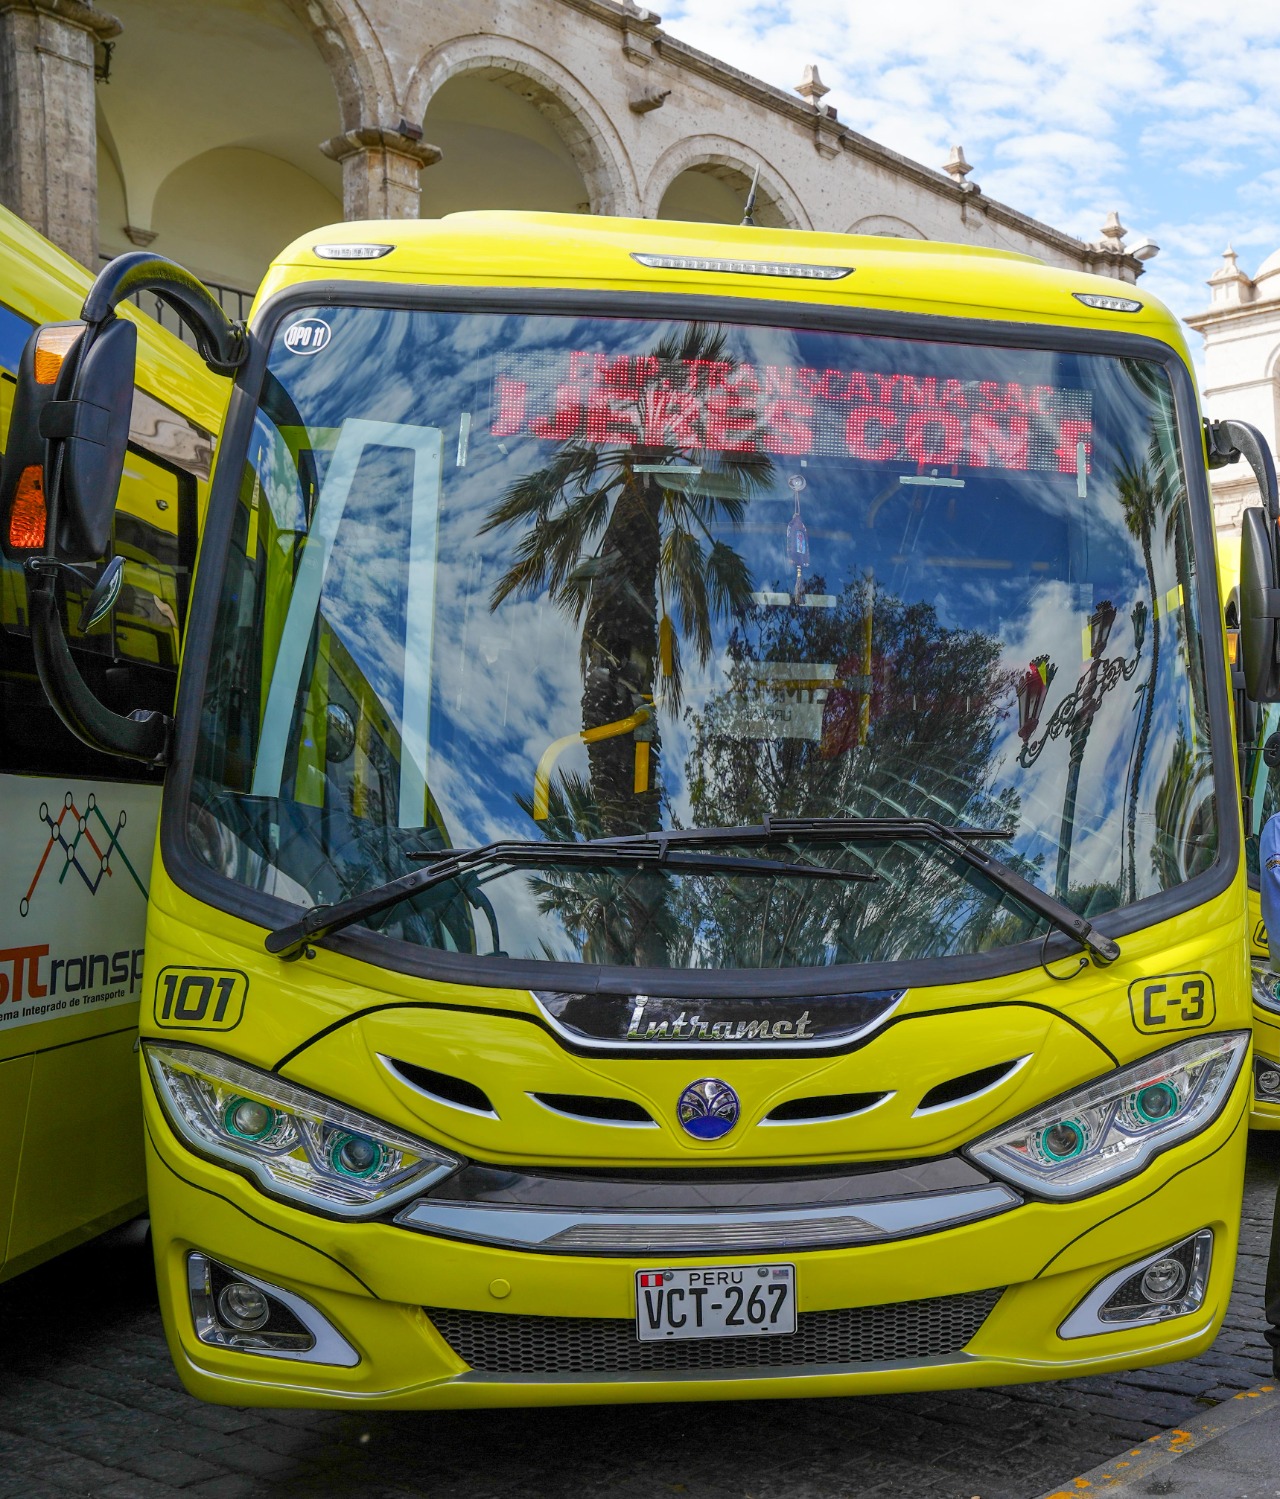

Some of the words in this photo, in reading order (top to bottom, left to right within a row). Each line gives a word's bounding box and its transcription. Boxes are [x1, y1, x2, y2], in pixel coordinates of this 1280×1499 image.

[312, 327, 326, 347] 11
[979, 381, 1053, 415] SAC
[843, 404, 1028, 471] CON
[22, 1001, 67, 1017] Integrado
[69, 997, 80, 1008] de
[83, 989, 125, 1004] Transporte
[161, 974, 236, 1022] 101
[627, 995, 816, 1041] Intramet
[1144, 980, 1205, 1026] C-3
[689, 1271, 743, 1286] PERU
[645, 1284, 788, 1330] VCT-267
